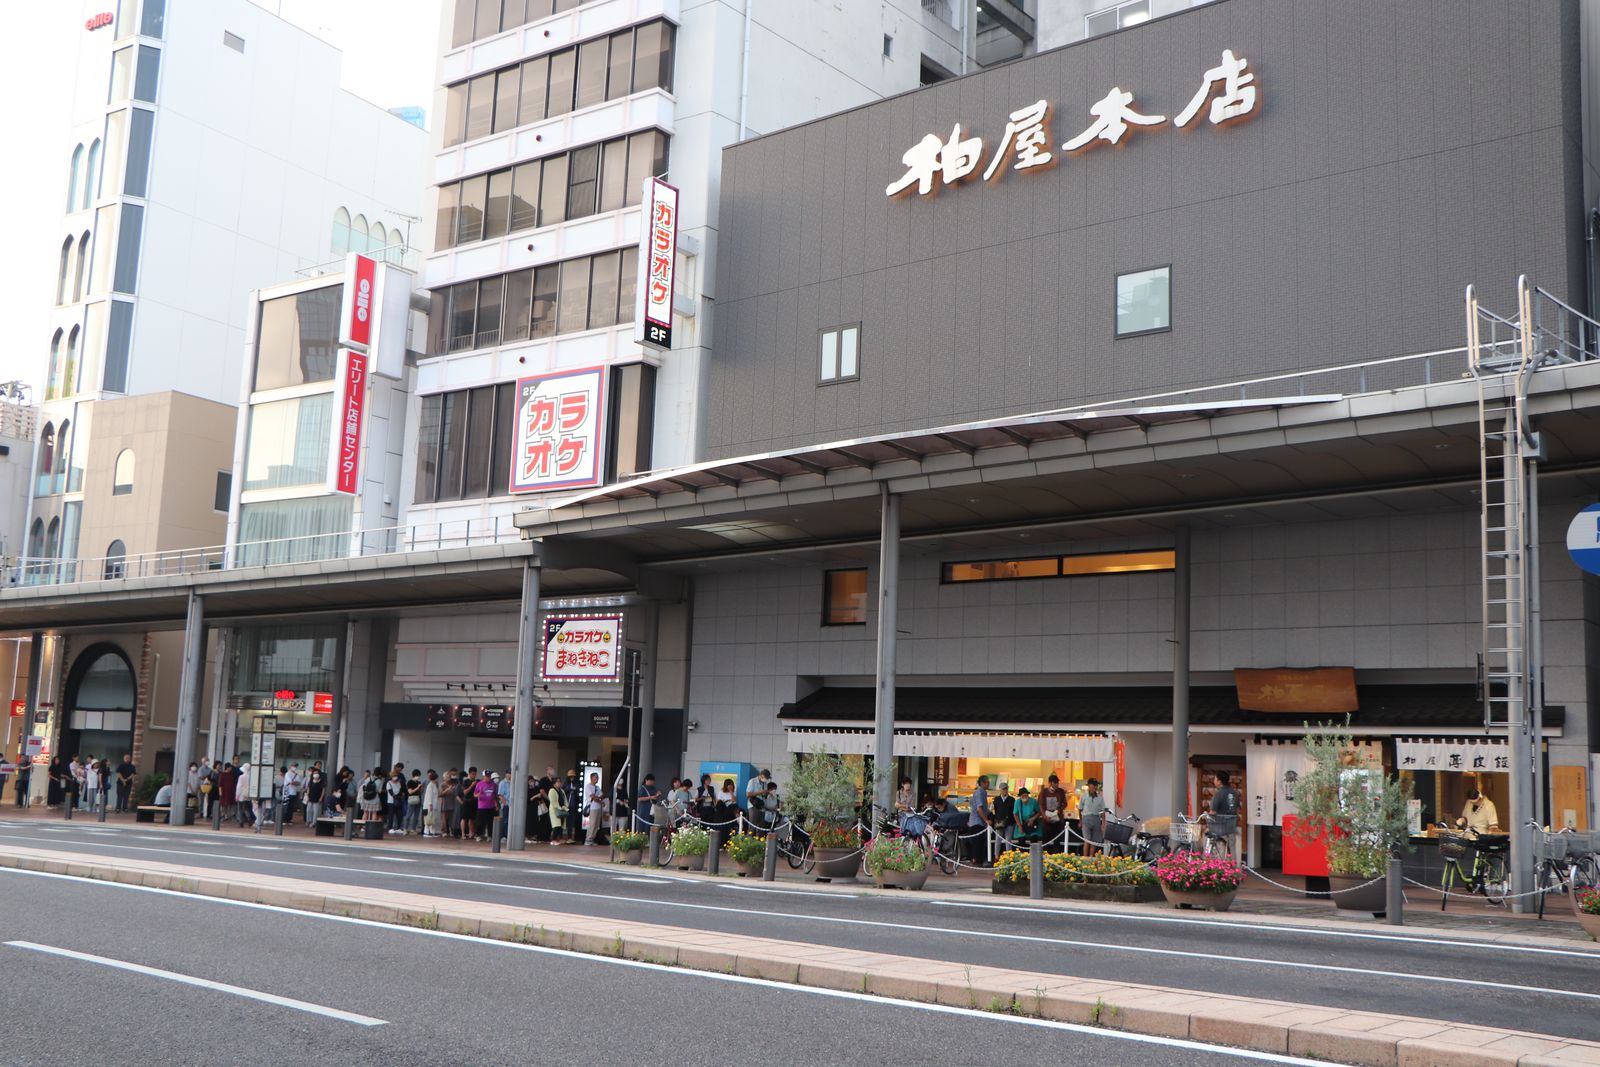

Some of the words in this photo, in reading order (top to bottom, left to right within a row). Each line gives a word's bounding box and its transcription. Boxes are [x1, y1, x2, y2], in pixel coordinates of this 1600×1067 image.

[85, 12, 113, 31] elite
[885, 49, 1256, 196] 柏屋本店
[652, 201, 673, 303] カラオケ
[357, 278, 370, 322] elite
[650, 326, 667, 342] 2F
[522, 386, 536, 397] 2F
[527, 391, 588, 437] カラ
[525, 436, 586, 478] オケ
[549, 624, 561, 632] 2F
[564, 630, 604, 643] カラオケ
[556, 649, 609, 669] まねきねこ
